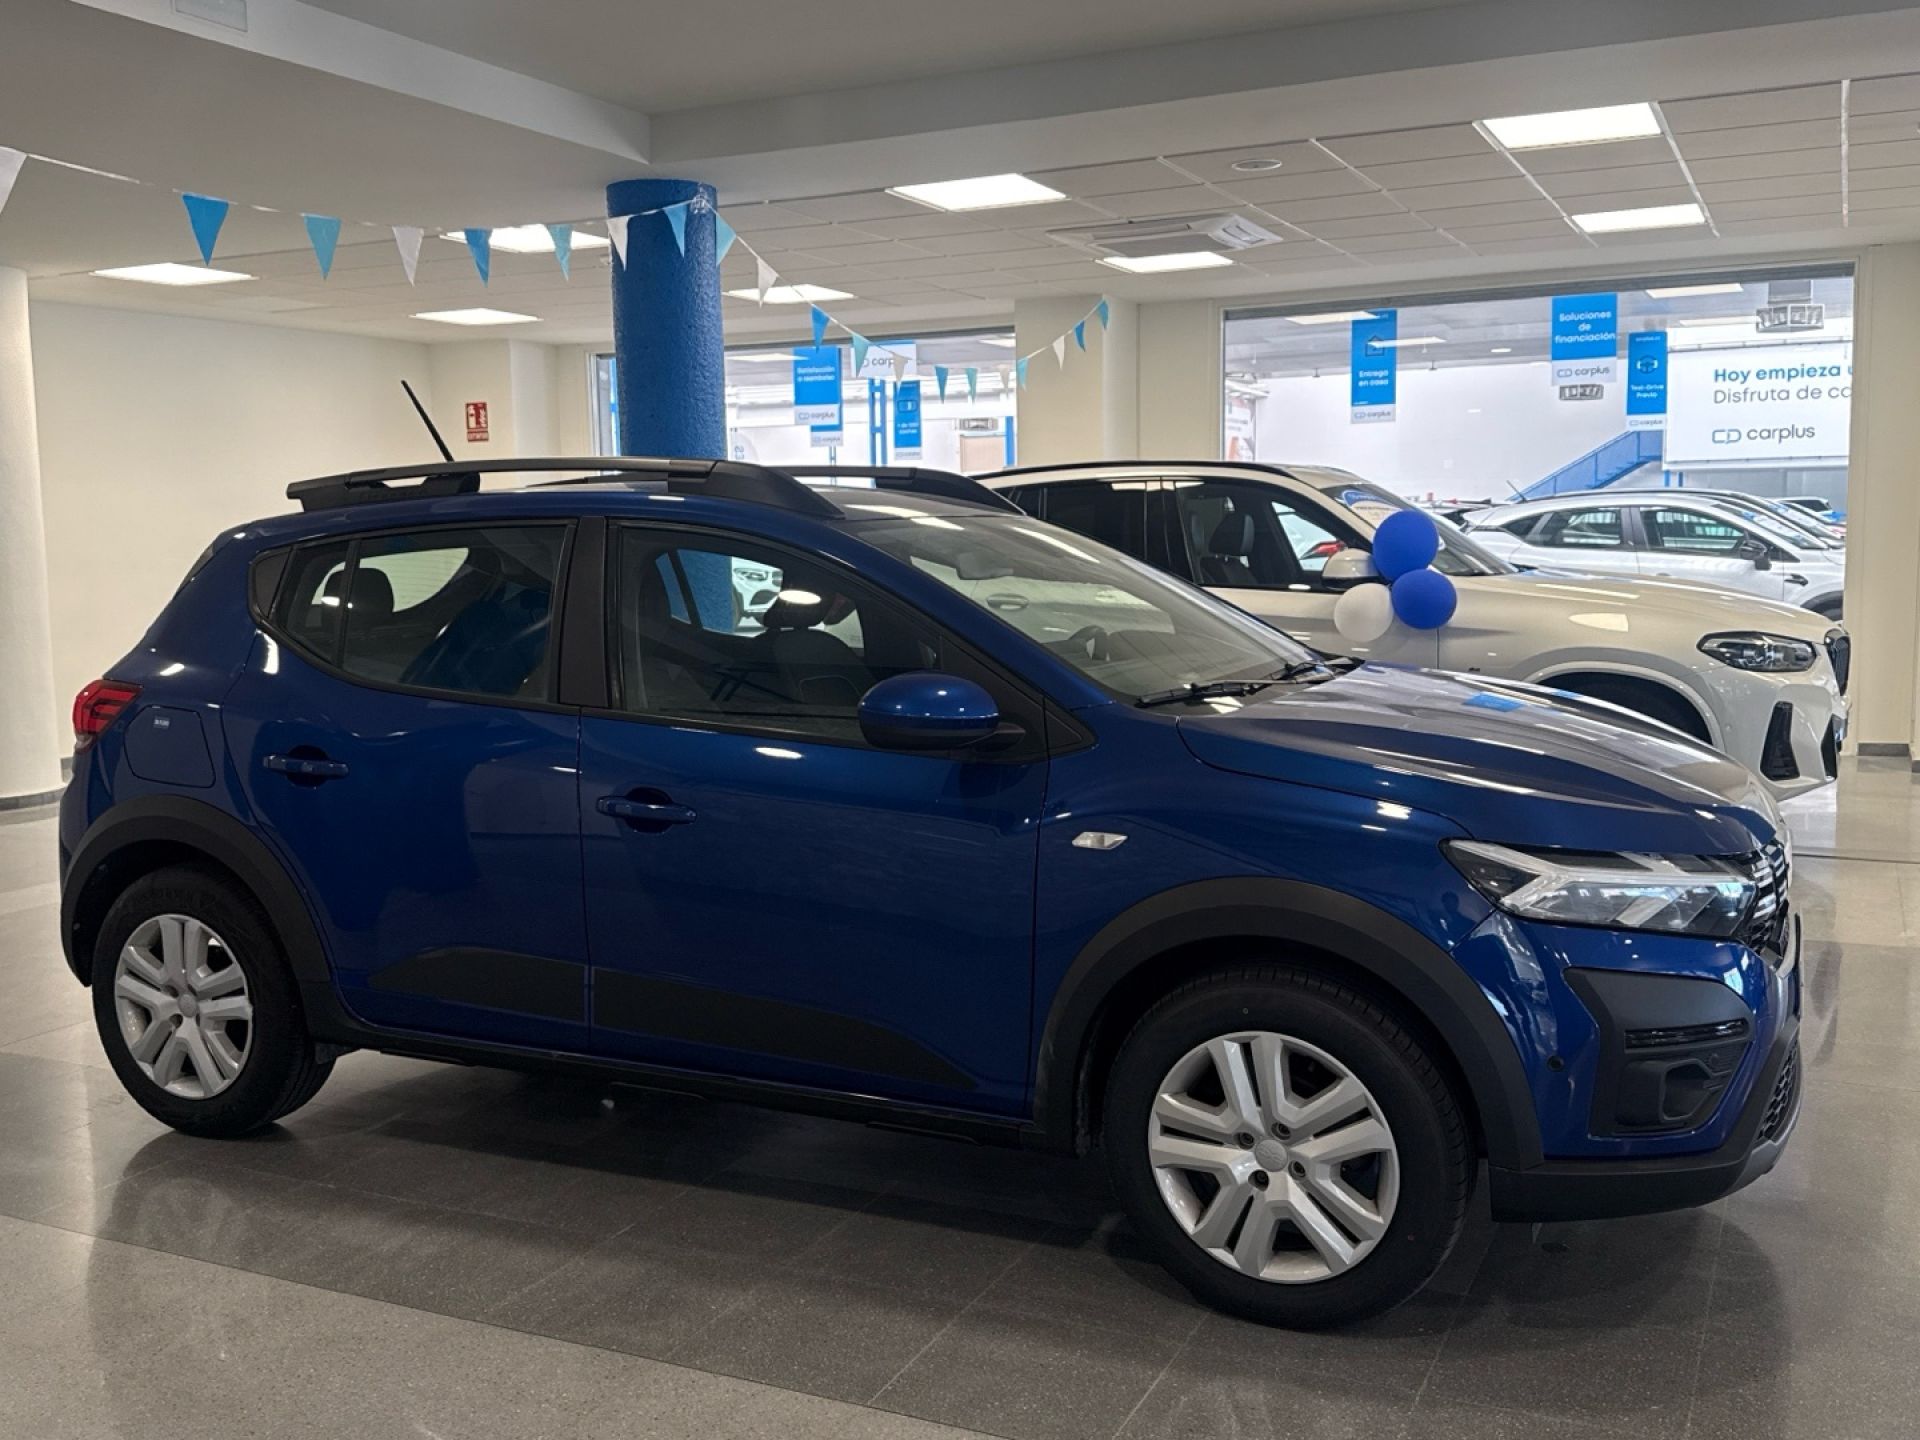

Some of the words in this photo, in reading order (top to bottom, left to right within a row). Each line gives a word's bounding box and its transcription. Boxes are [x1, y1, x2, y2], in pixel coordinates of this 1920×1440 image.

[1559, 311, 1611, 321] Soluciones
[1578, 322, 1591, 331] de
[1554, 332, 1616, 344] financiación
[1574, 366, 1610, 377] carplus
[1714, 367, 1751, 384] Hoy
[1755, 363, 1841, 382] empieza
[1713, 388, 1790, 404] Disfruta
[1796, 385, 1823, 399] de
[1746, 424, 1816, 444] carplus
